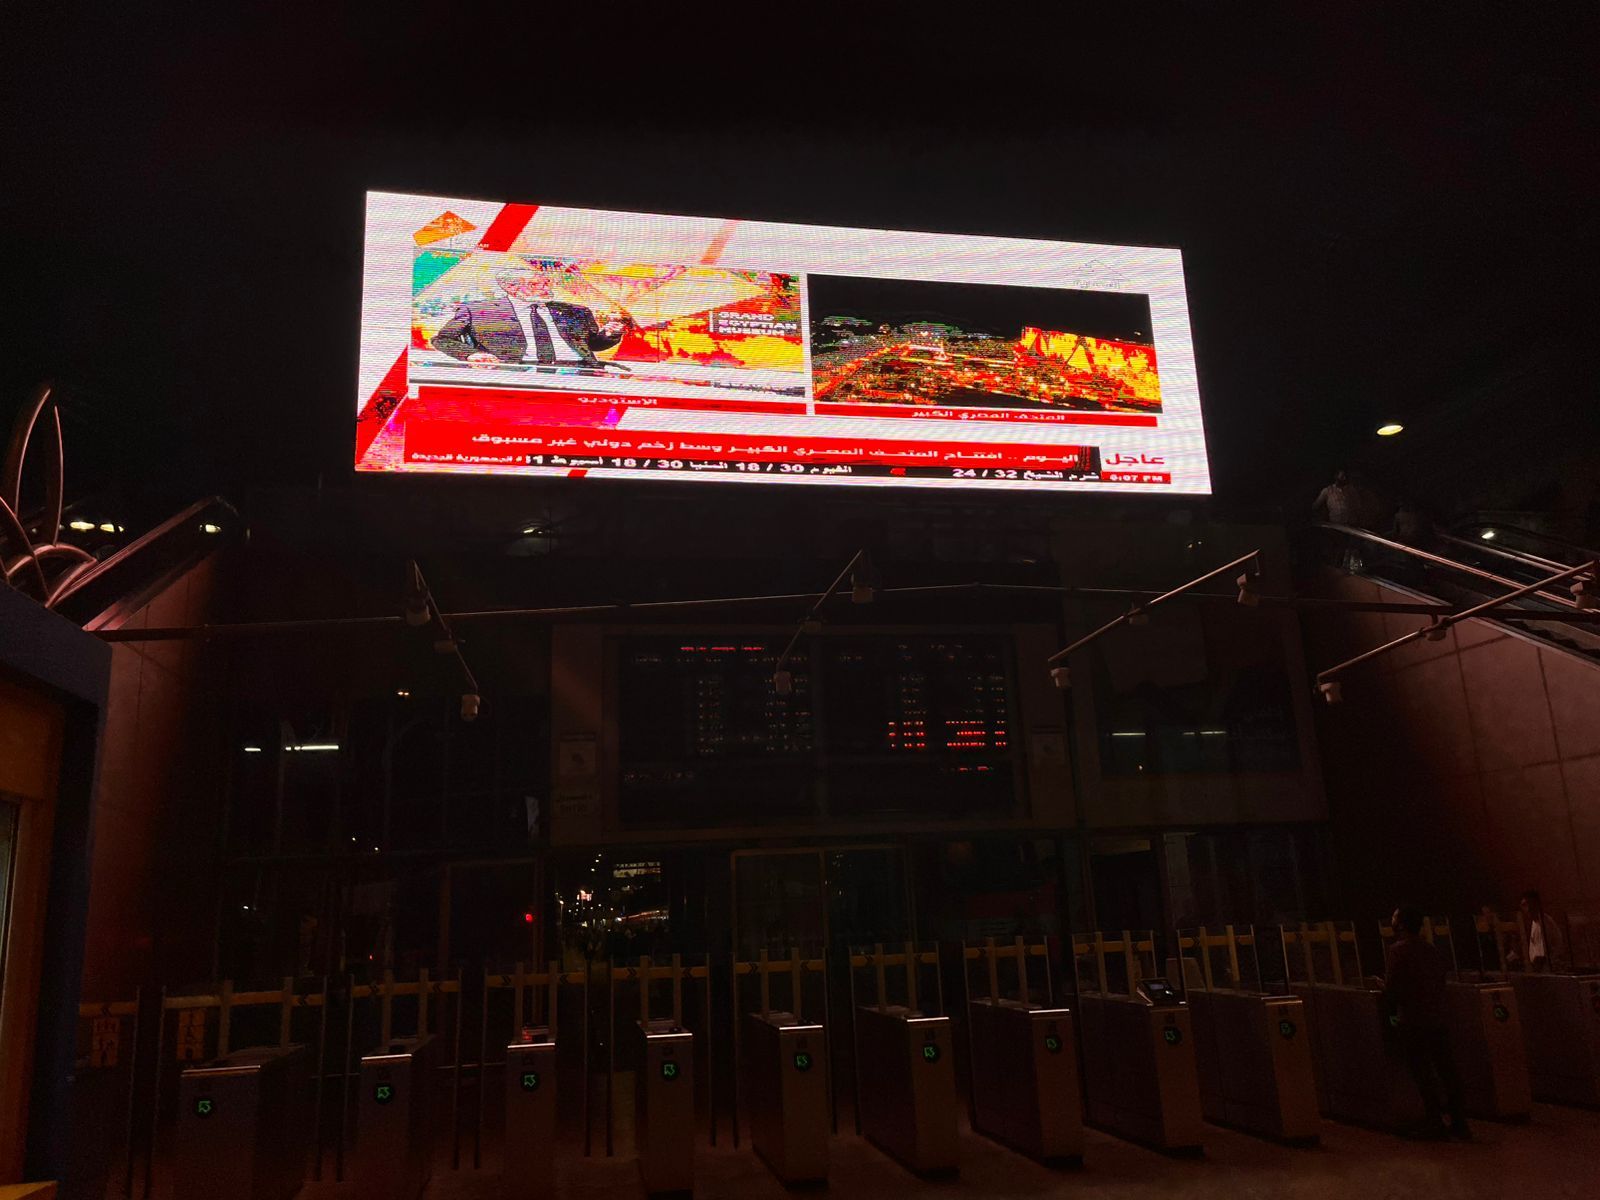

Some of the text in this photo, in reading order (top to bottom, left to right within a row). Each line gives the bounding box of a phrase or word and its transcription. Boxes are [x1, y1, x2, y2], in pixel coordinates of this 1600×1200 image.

[471, 433, 543, 445] مسبوق
[546, 436, 578, 447] غير
[583, 438, 632, 449] دولي
[679, 441, 723, 453] وسط
[657, 459, 684, 469] 30
[1105, 453, 1165, 467] عاجل
[779, 463, 805, 473] 30
[951, 468, 977, 478] 24
[994, 469, 1019, 479] 32
